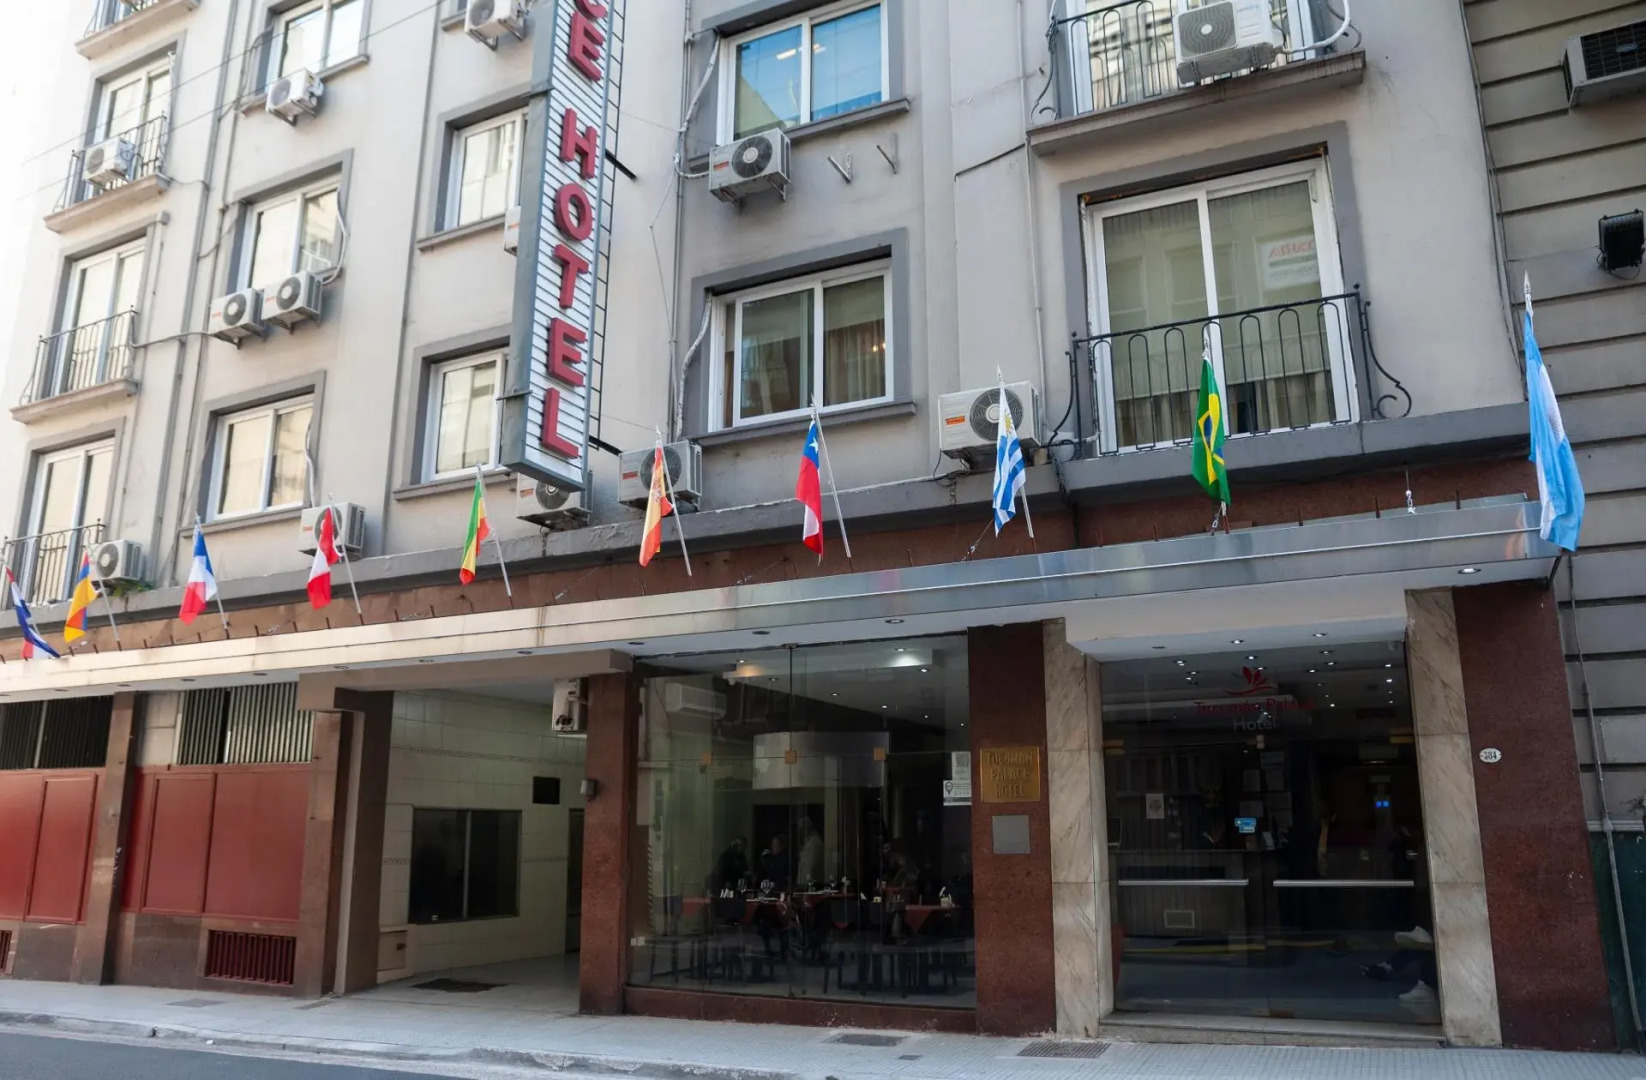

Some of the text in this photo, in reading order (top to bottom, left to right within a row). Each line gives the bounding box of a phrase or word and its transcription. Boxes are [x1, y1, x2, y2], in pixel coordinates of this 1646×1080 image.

[541, 107, 598, 459] HOTEL
[1232, 716, 1277, 731] Hotel
[995, 783, 1026, 799] HOTEL
